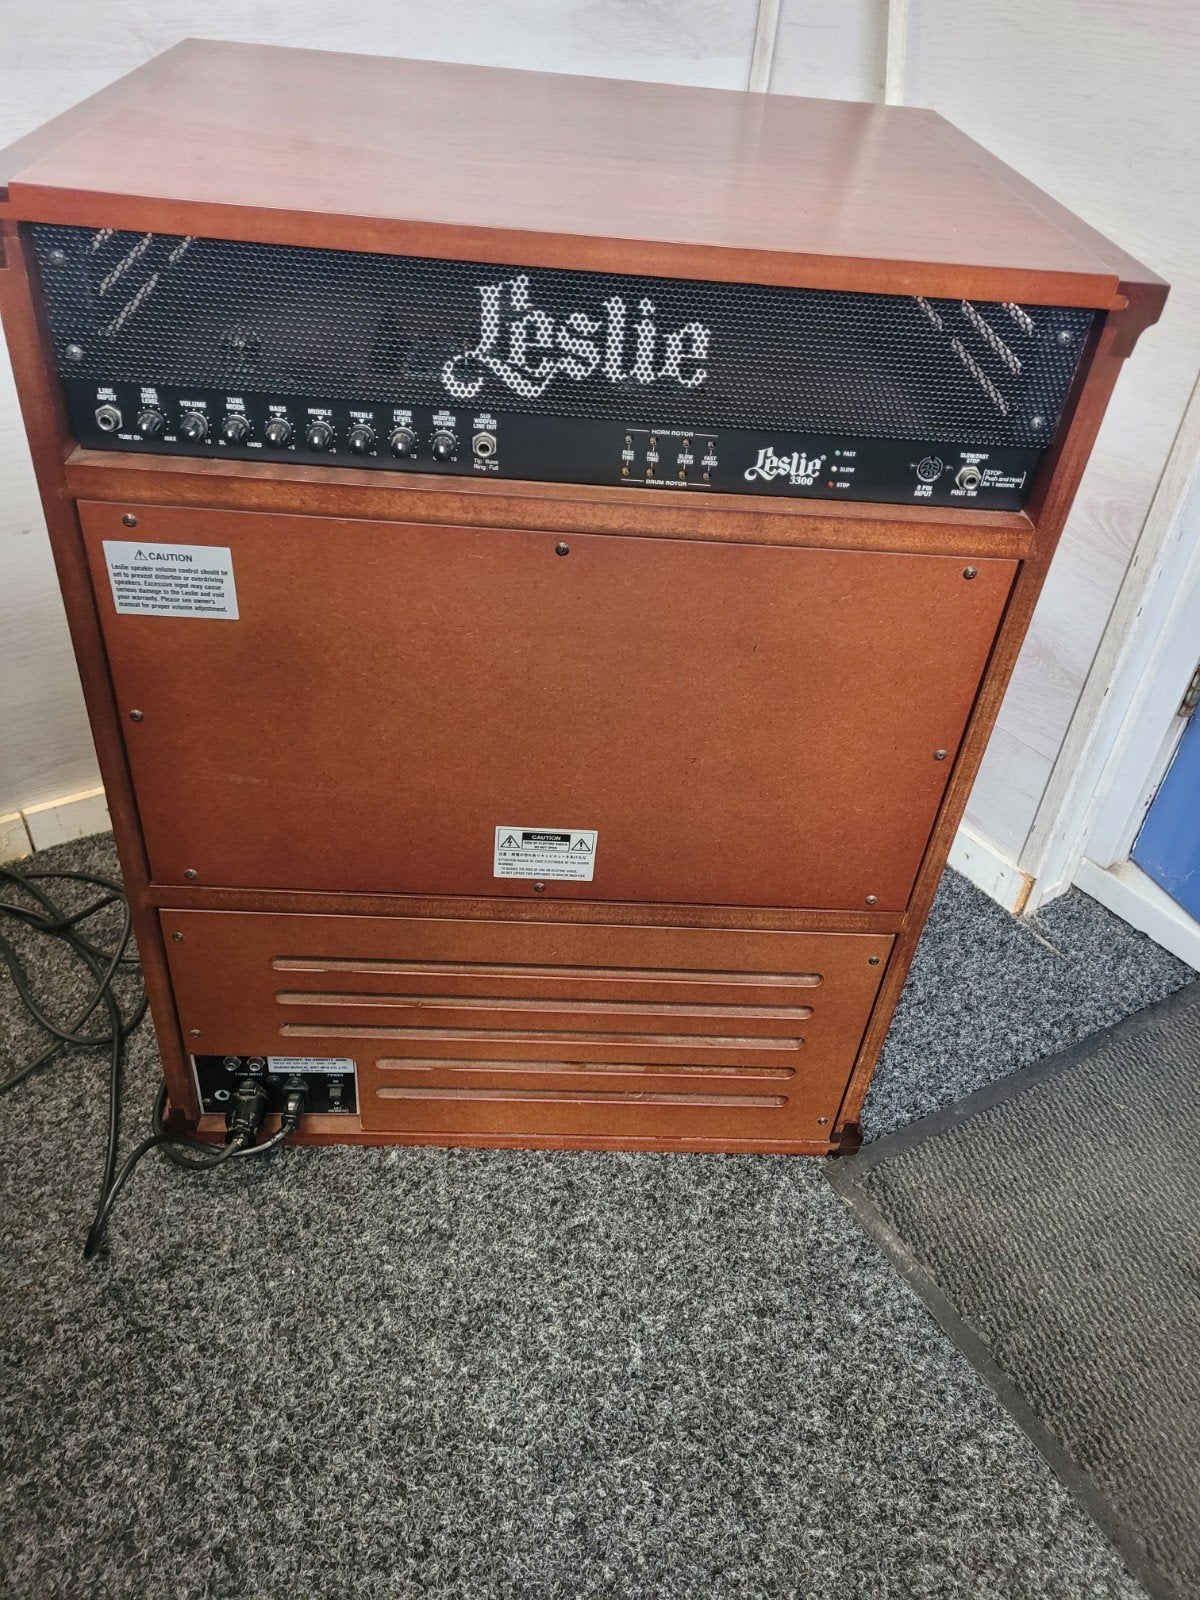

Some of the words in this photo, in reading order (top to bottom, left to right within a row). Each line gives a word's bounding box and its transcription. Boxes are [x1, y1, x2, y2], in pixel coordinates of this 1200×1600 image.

[441, 274, 711, 398] Leslie
[179, 400, 206, 408] VOLUME
[308, 408, 332, 416] MIDDLE
[350, 411, 374, 419] TREBLE
[744, 446, 822, 481] Leslie
[789, 475, 814, 486] 3300
[148, 552, 193, 562] CAUTION
